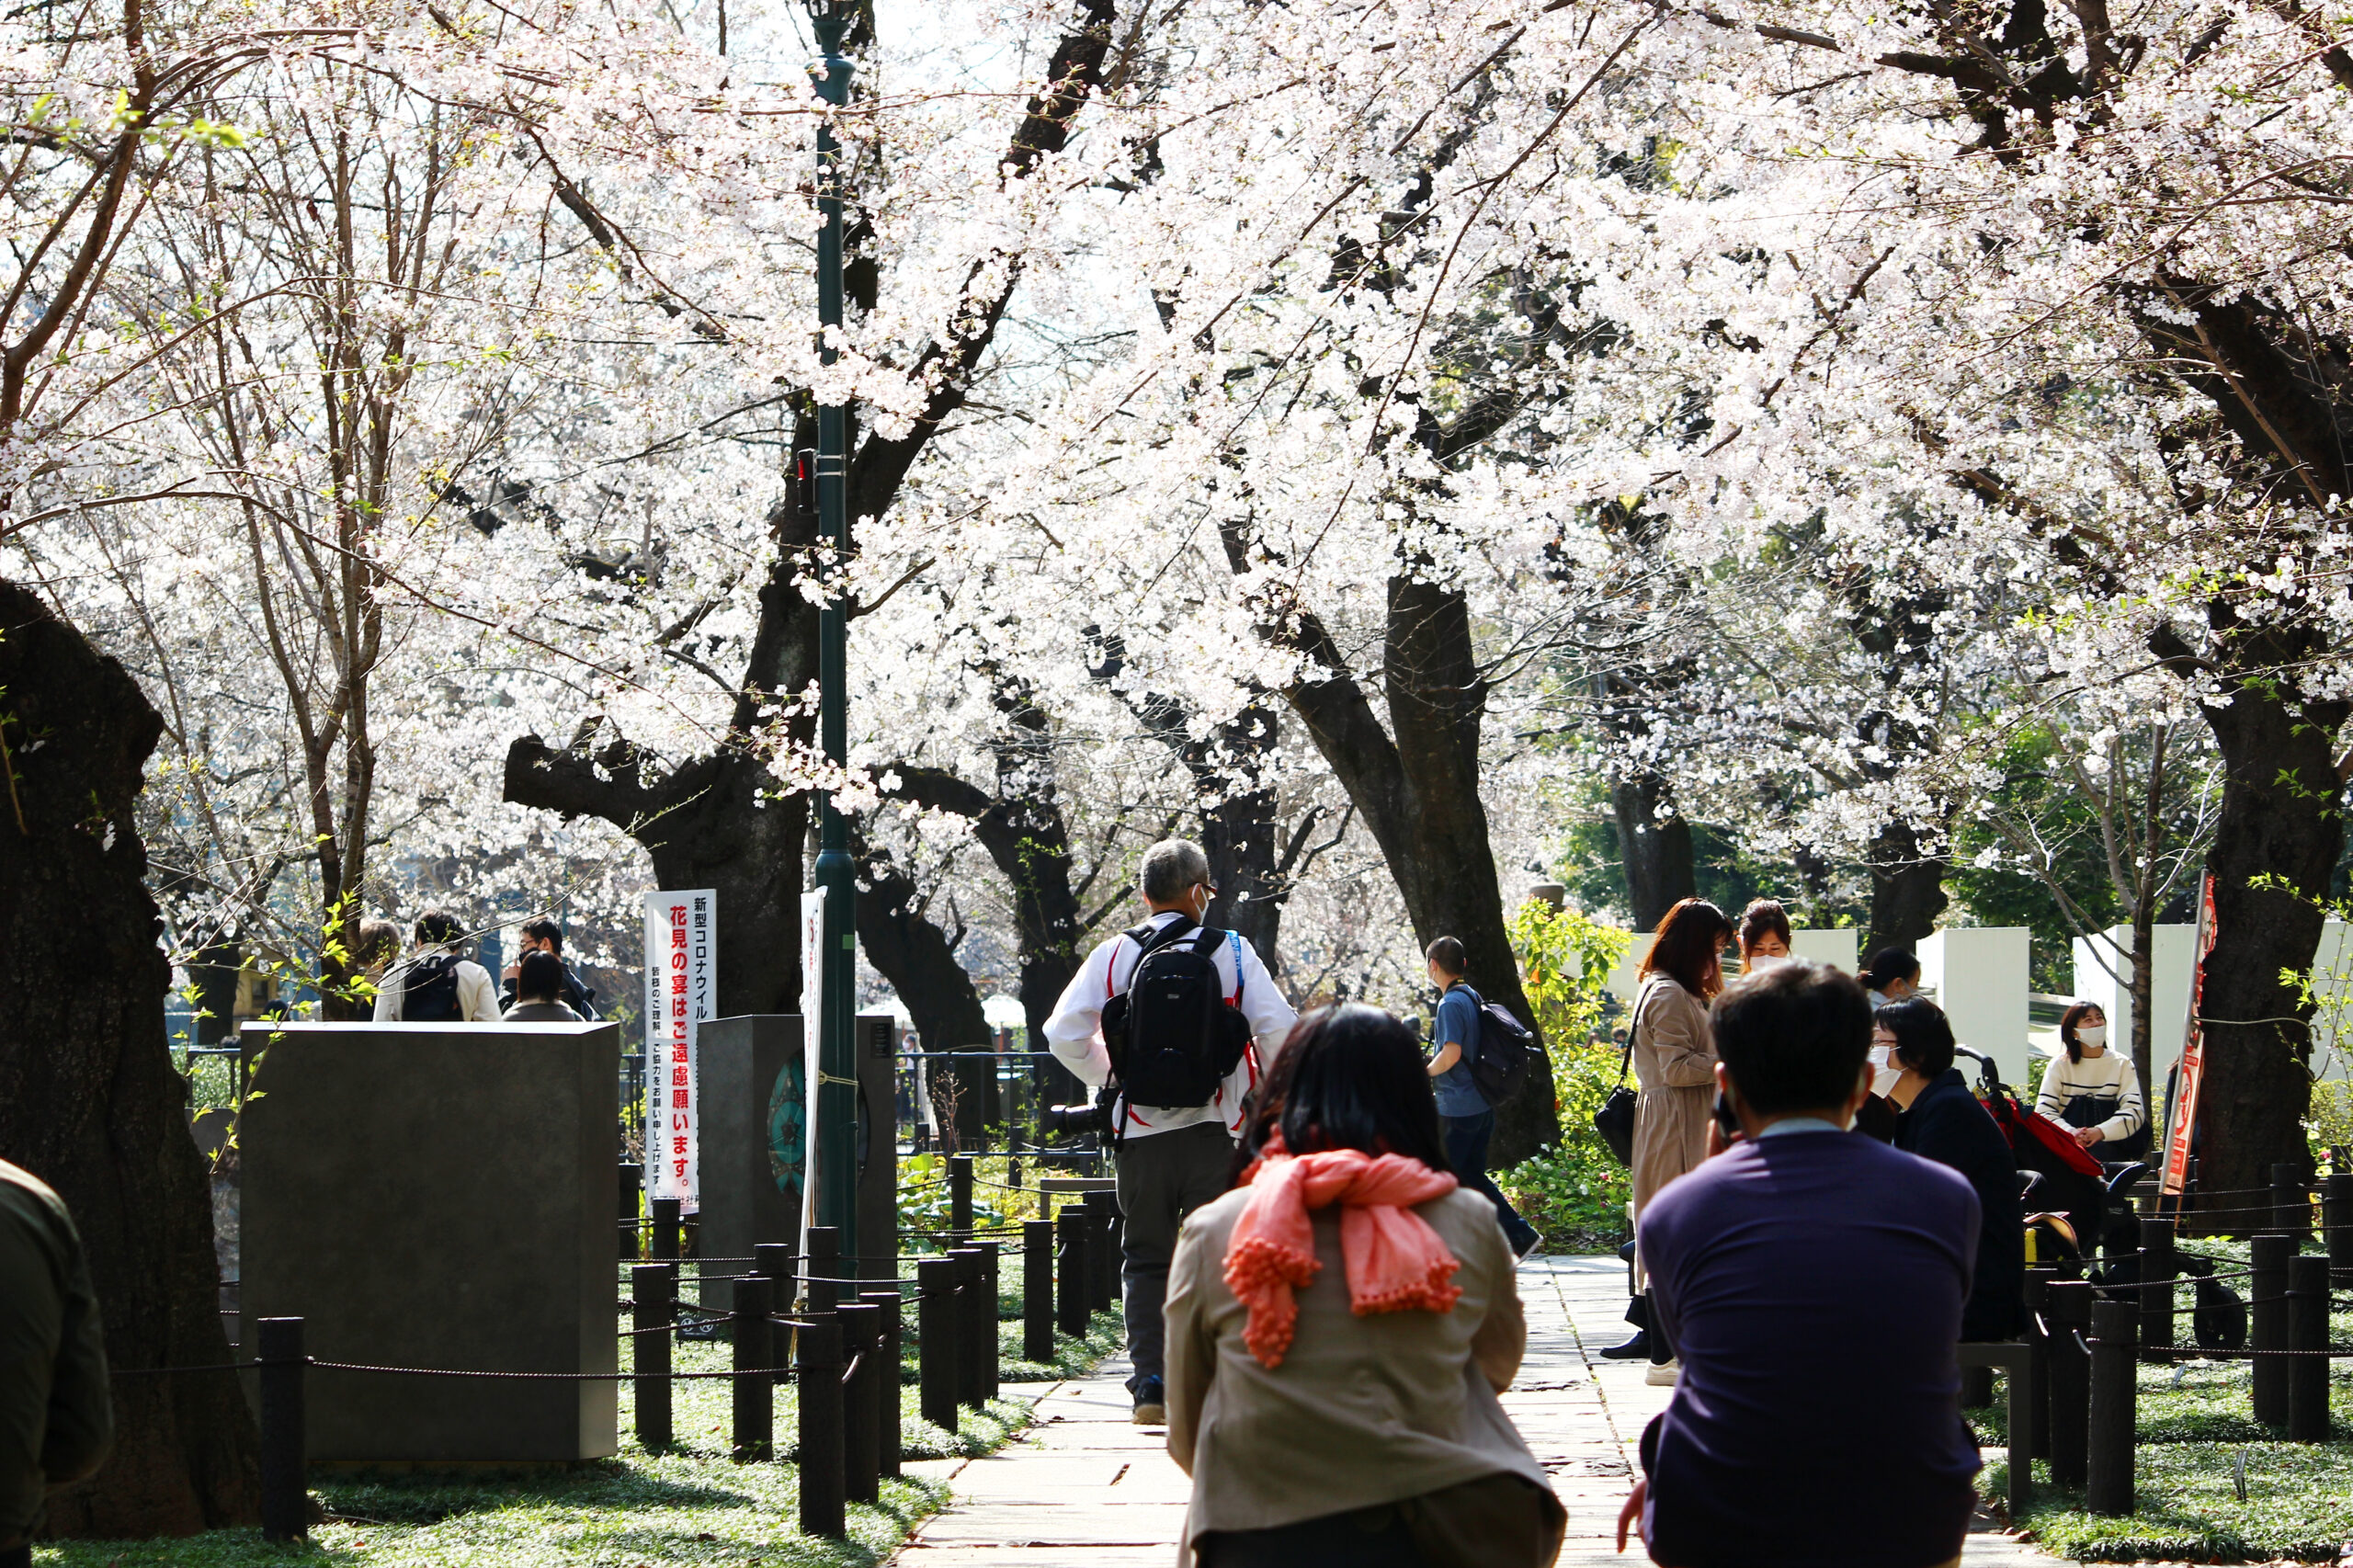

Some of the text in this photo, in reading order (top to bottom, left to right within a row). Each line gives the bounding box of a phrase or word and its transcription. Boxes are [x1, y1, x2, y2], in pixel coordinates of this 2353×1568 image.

[670, 905, 688, 1187] 花見の宴はご遠慮願います。
